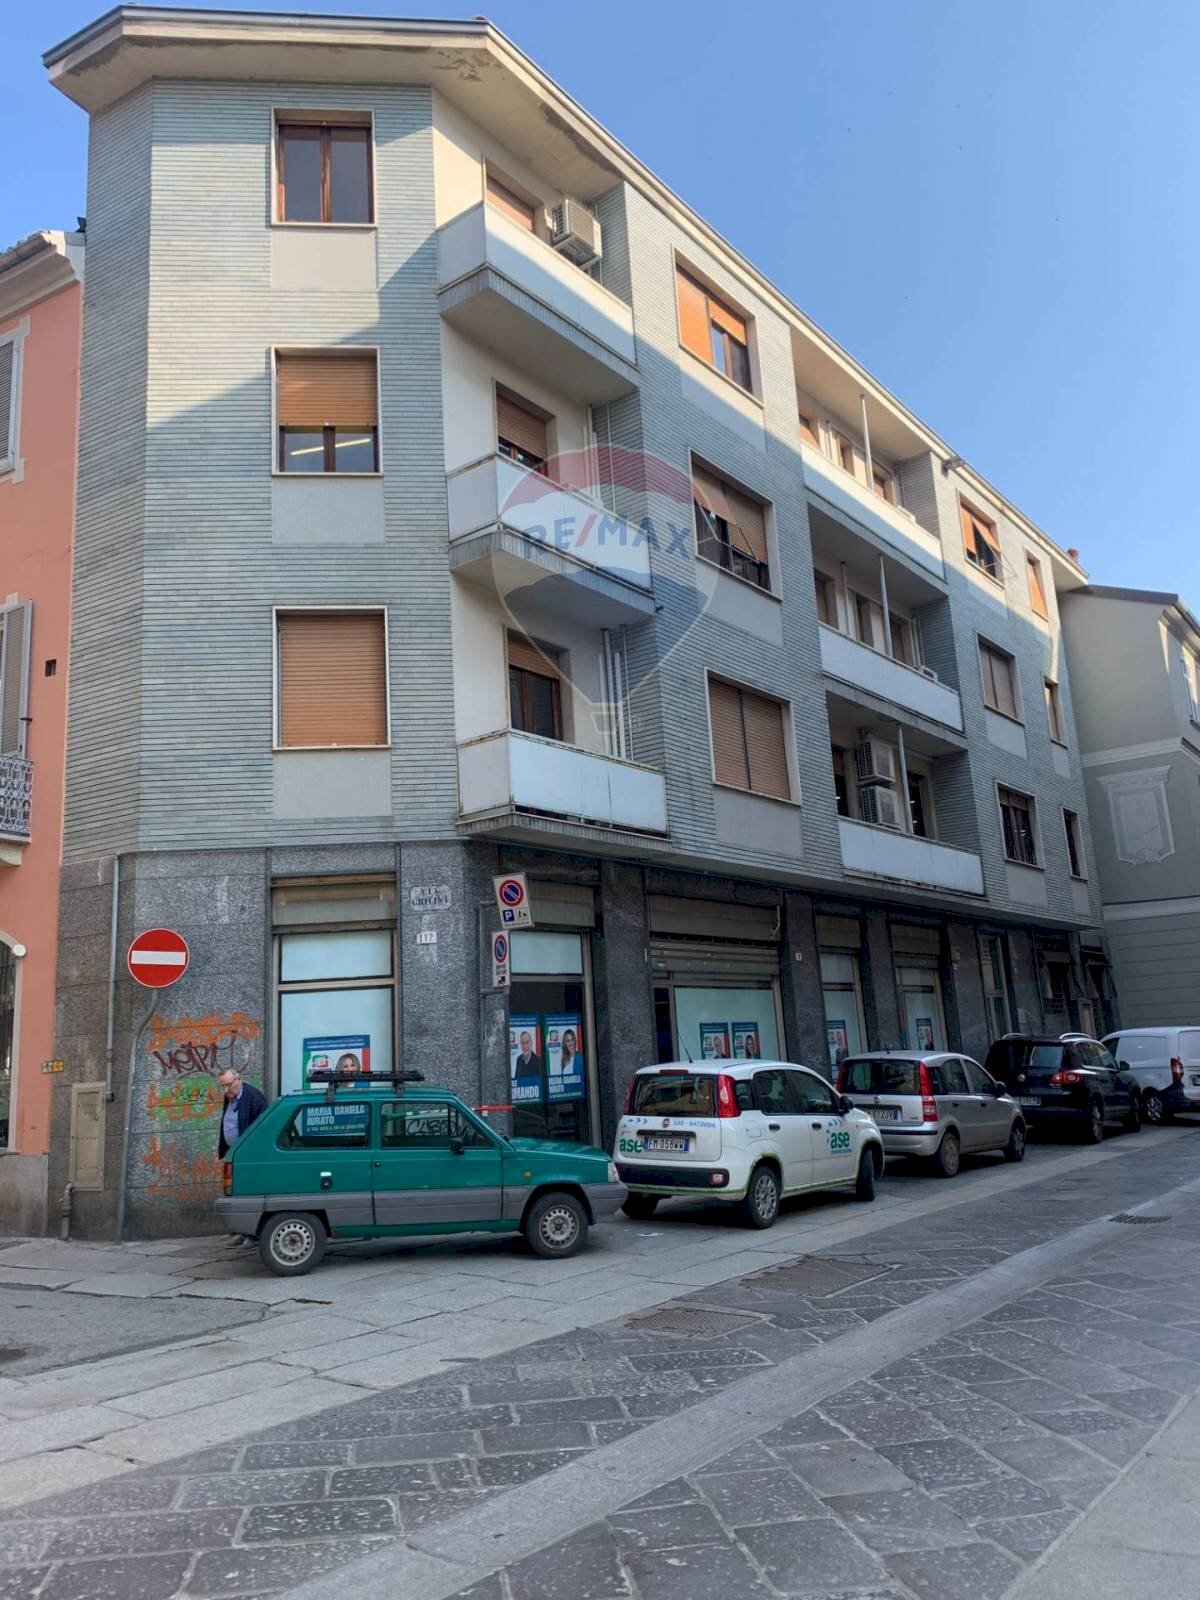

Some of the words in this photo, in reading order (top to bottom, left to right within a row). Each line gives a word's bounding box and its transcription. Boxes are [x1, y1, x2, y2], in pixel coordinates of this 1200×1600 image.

[307, 1106, 332, 1117] MARIA
[335, 1104, 366, 1115] DANIELA
[307, 1116, 335, 1126] IURATO
[619, 1138, 643, 1153] ase
[831, 1131, 850, 1149] ase
